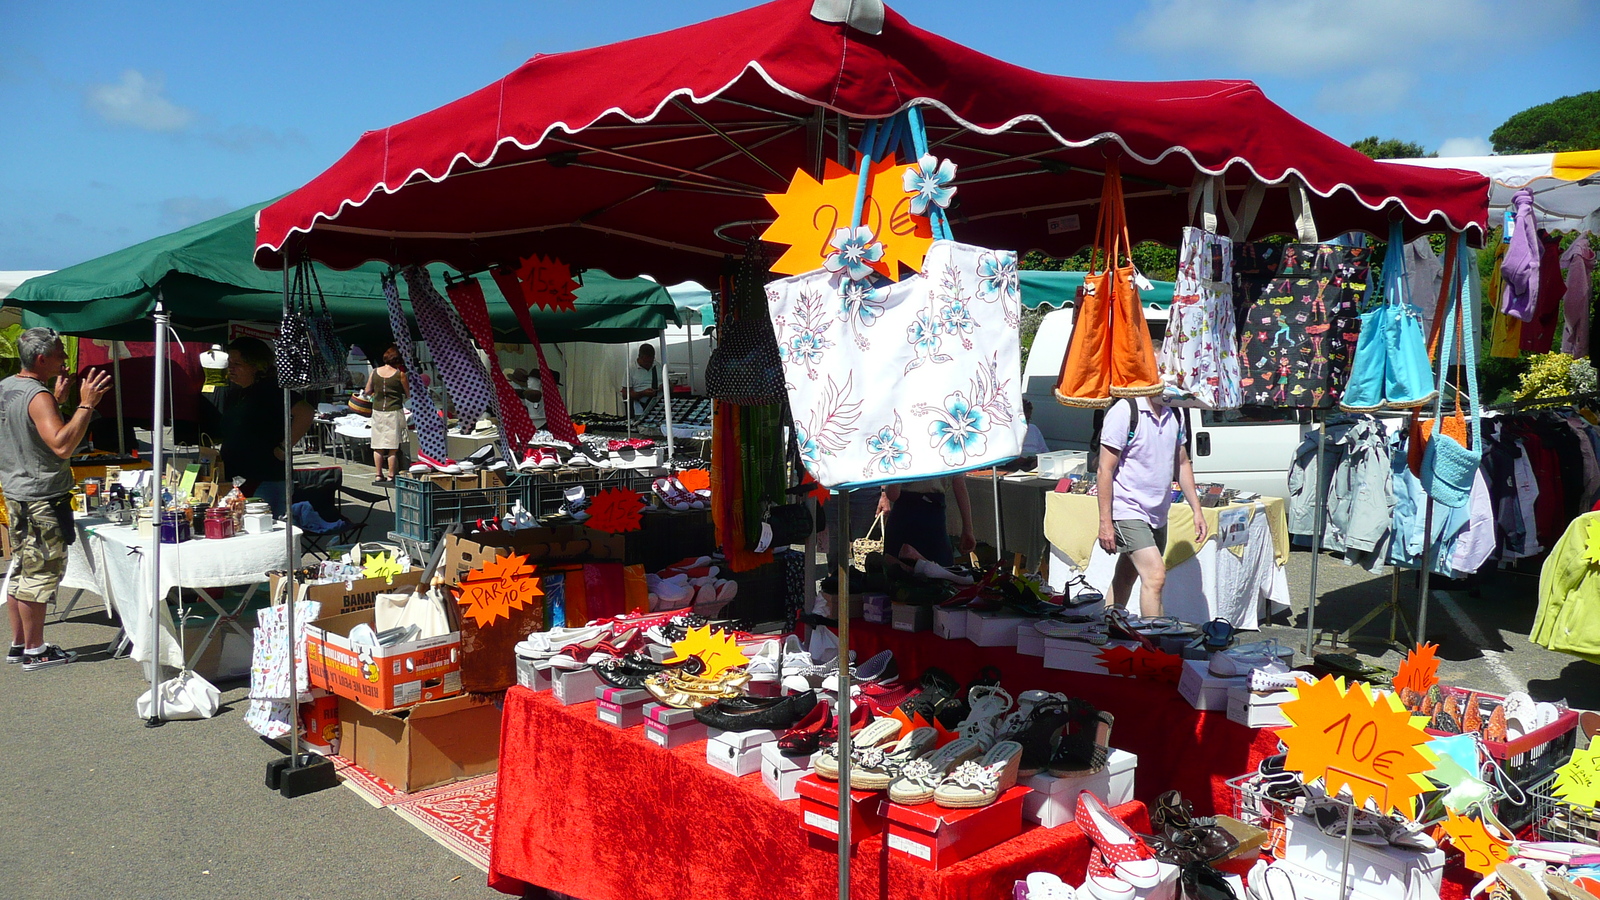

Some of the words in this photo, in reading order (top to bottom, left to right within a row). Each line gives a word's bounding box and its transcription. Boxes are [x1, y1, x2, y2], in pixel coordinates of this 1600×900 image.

[604, 500, 638, 523] 15€
[501, 581, 530, 606] 10€
[1407, 667, 1432, 691] 10€
[1323, 713, 1405, 780] 10€
[1459, 835, 1507, 867] 5€
